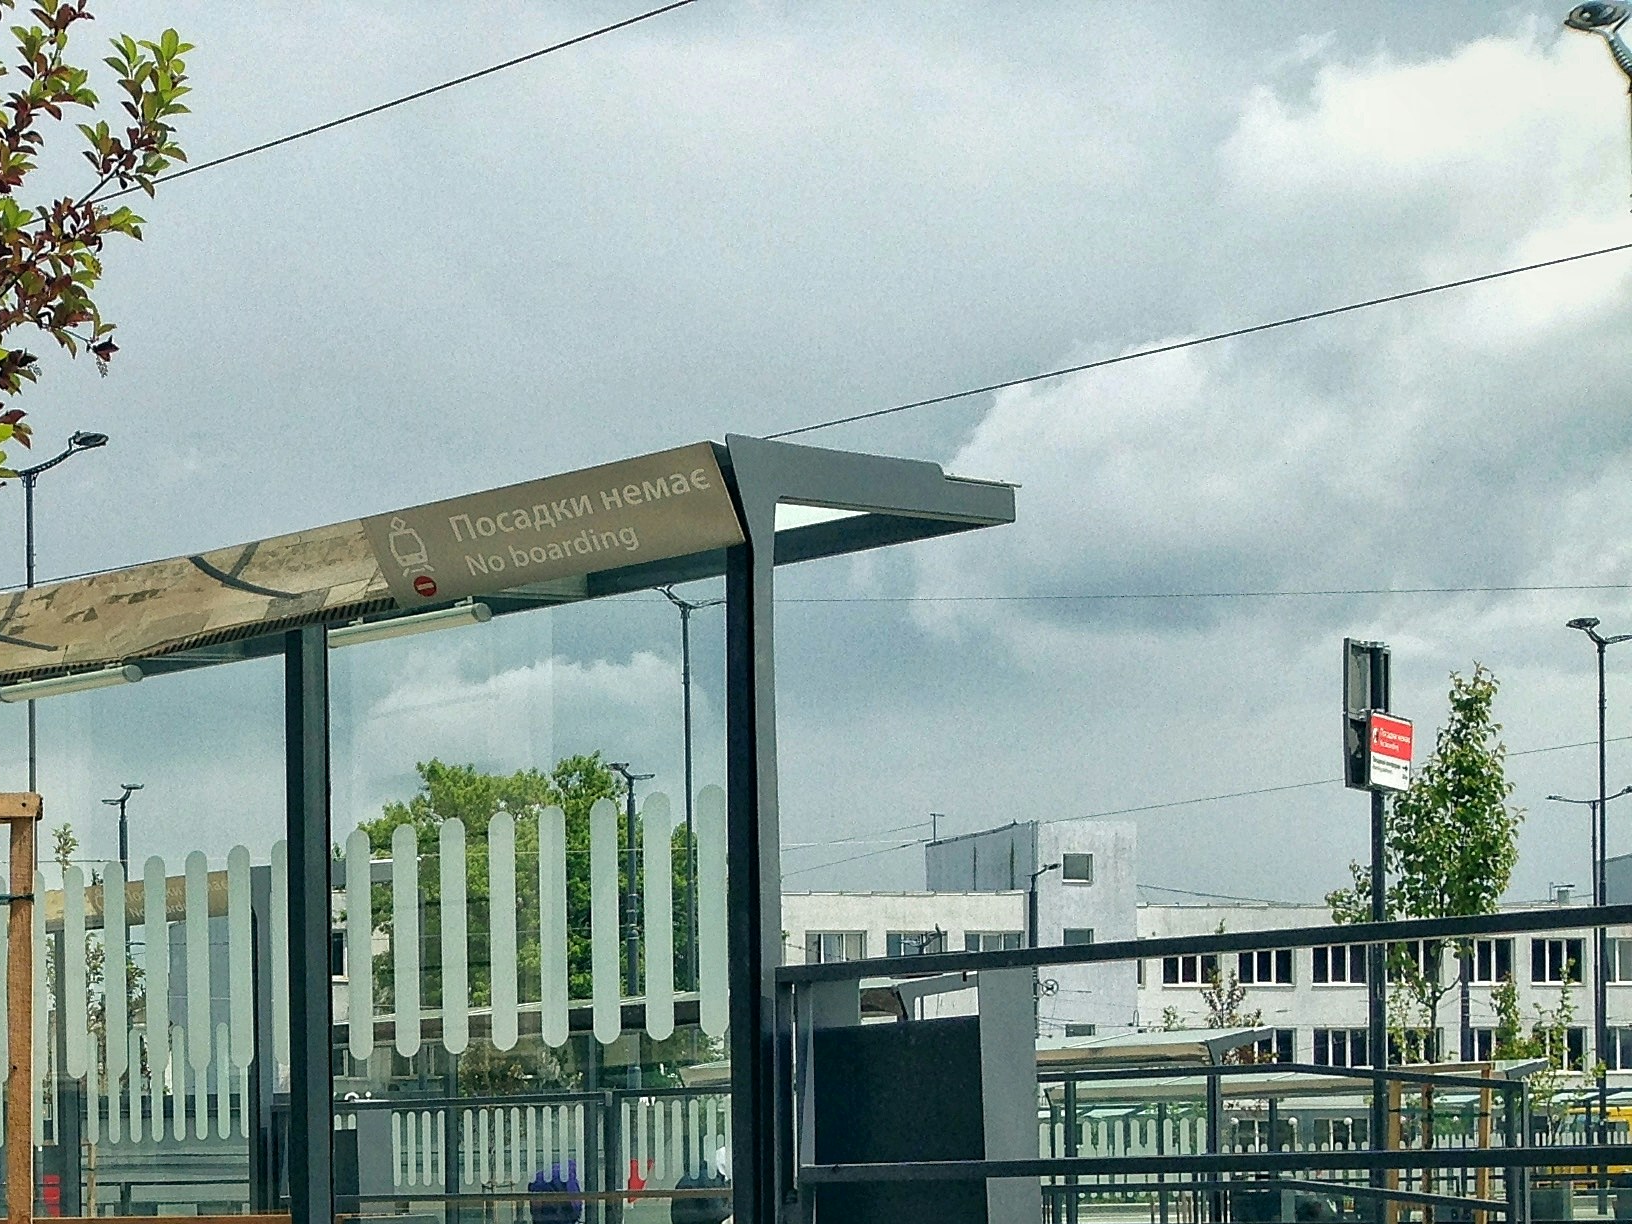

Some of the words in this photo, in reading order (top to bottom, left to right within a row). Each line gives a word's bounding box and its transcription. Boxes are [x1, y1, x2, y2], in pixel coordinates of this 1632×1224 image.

[448, 493, 594, 543] Посадки
[599, 468, 711, 511] немає
[464, 553, 506, 576] No
[508, 526, 640, 568] boarding
